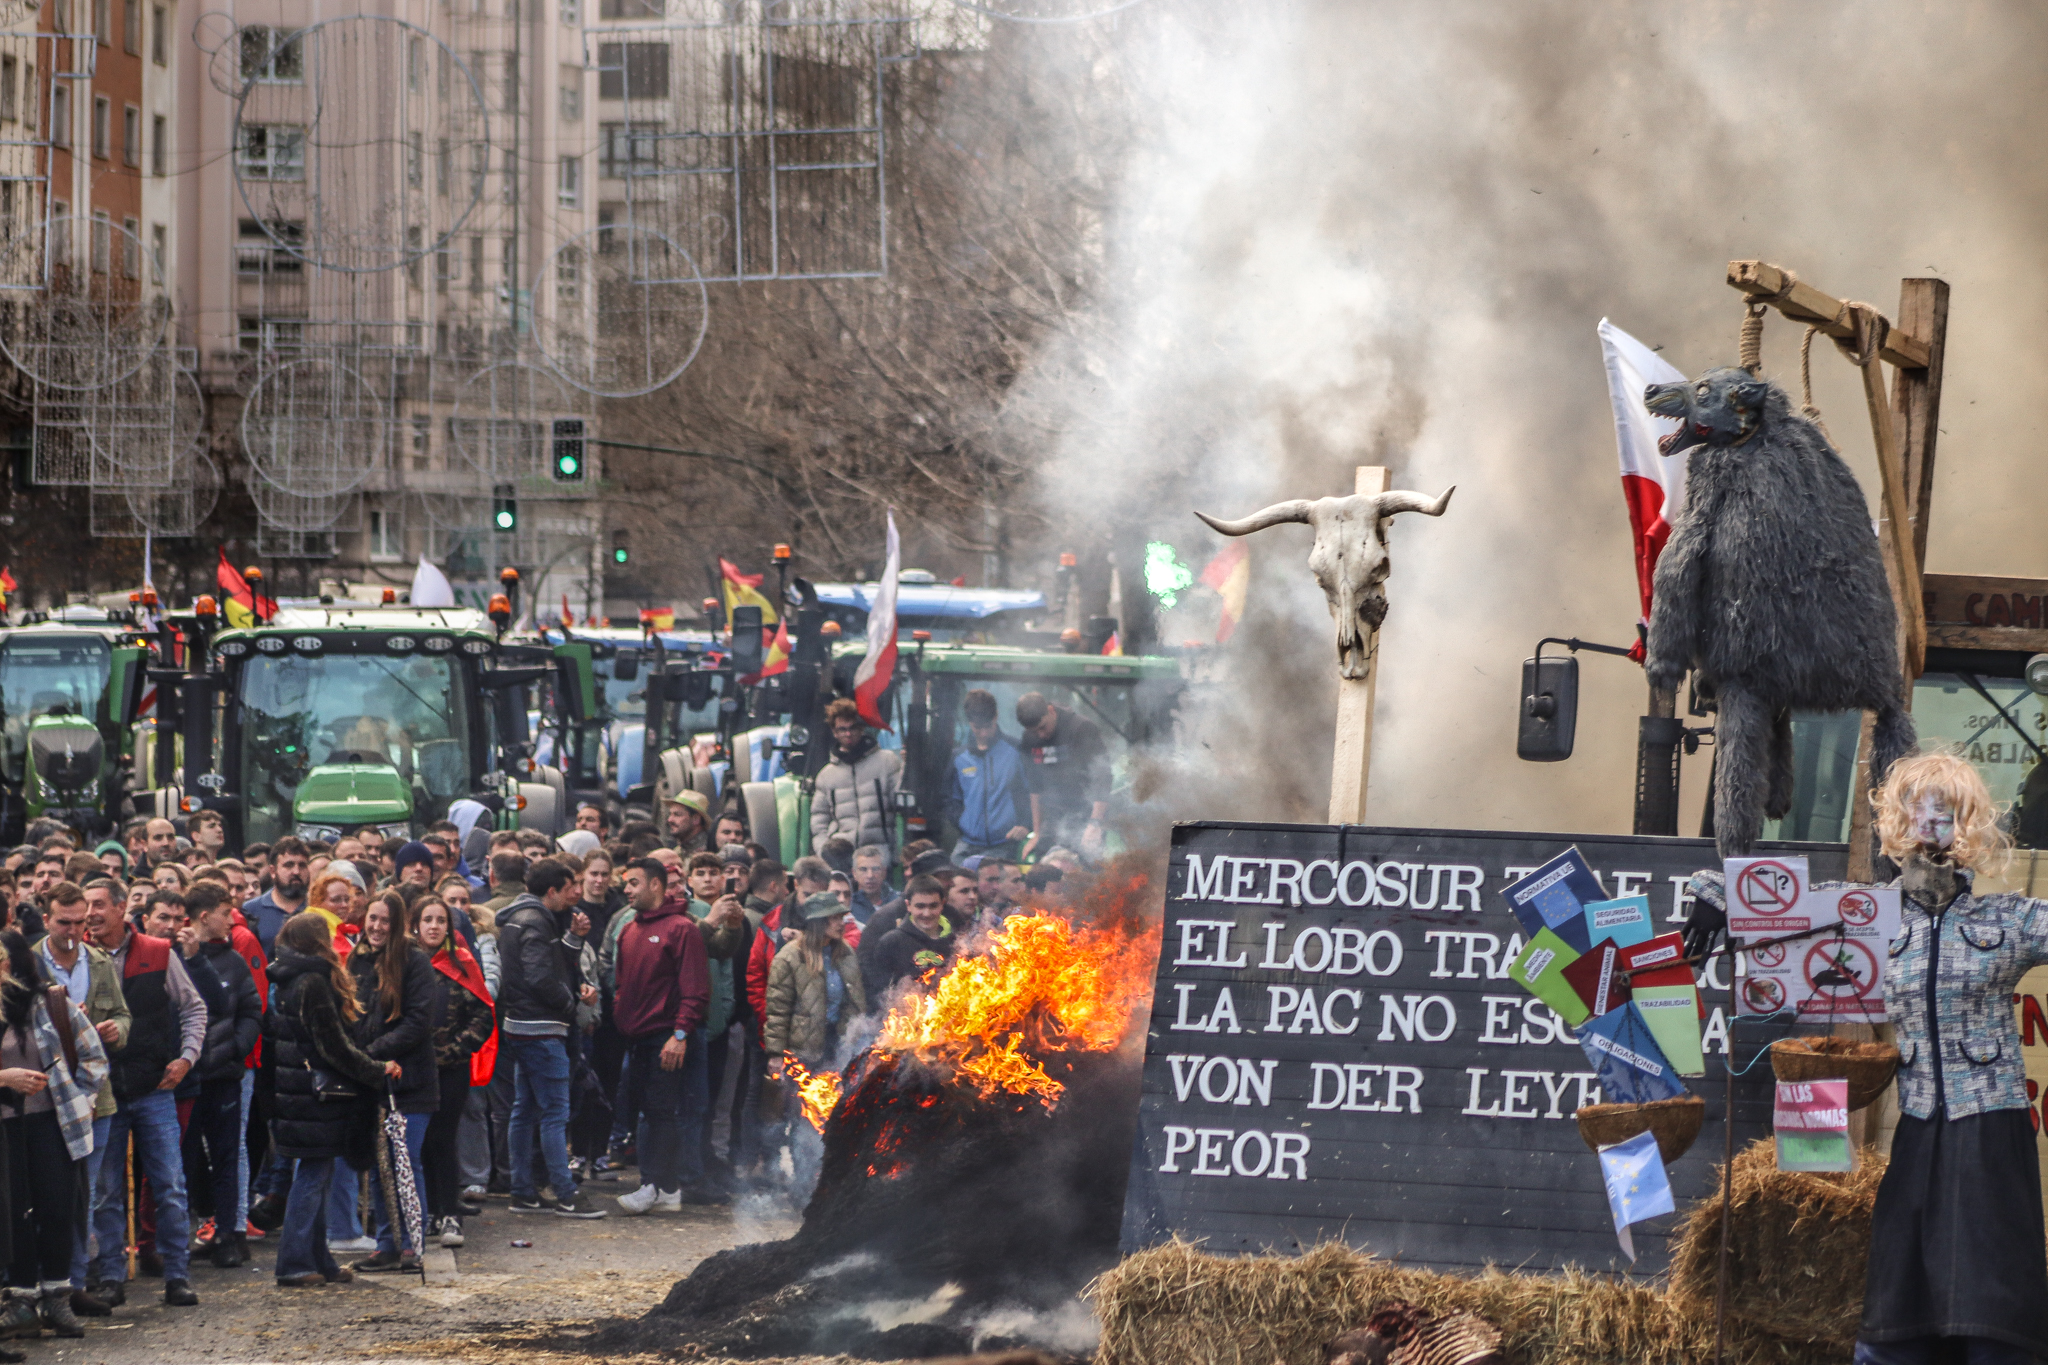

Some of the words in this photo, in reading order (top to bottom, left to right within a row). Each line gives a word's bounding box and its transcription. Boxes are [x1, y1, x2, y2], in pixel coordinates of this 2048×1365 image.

[1964, 593, 2048, 628] CAM
[1181, 854, 1485, 912] MERCOSUR
[1515, 872, 1562, 903] NORMATIVA
[1595, 907, 1637, 918] SEGURIDAD
[1595, 914, 1643, 927] ALIMENTARIA
[1745, 920, 1773, 928] CONTROL
[1774, 920, 1783, 928] DE
[1173, 919, 1247, 968] EL
[1258, 922, 1403, 977] LOBO
[1425, 931, 1528, 979] TRA
[1602, 948, 1614, 974] ANIMAL
[1632, 949, 1674, 966] SANCIONES
[1170, 983, 1242, 1034] LA
[1263, 985, 1364, 1035] PAC
[1377, 994, 1458, 1042] NO
[1639, 998, 1691, 1008] TRAZABILIDAD
[1598, 1038, 1661, 1075] OBLIGACIONES
[1166, 1055, 1279, 1106] VON
[1306, 1062, 1425, 1114] DER
[1461, 1067, 1602, 1119] LEYE
[1158, 1125, 1311, 1181] PEOR
